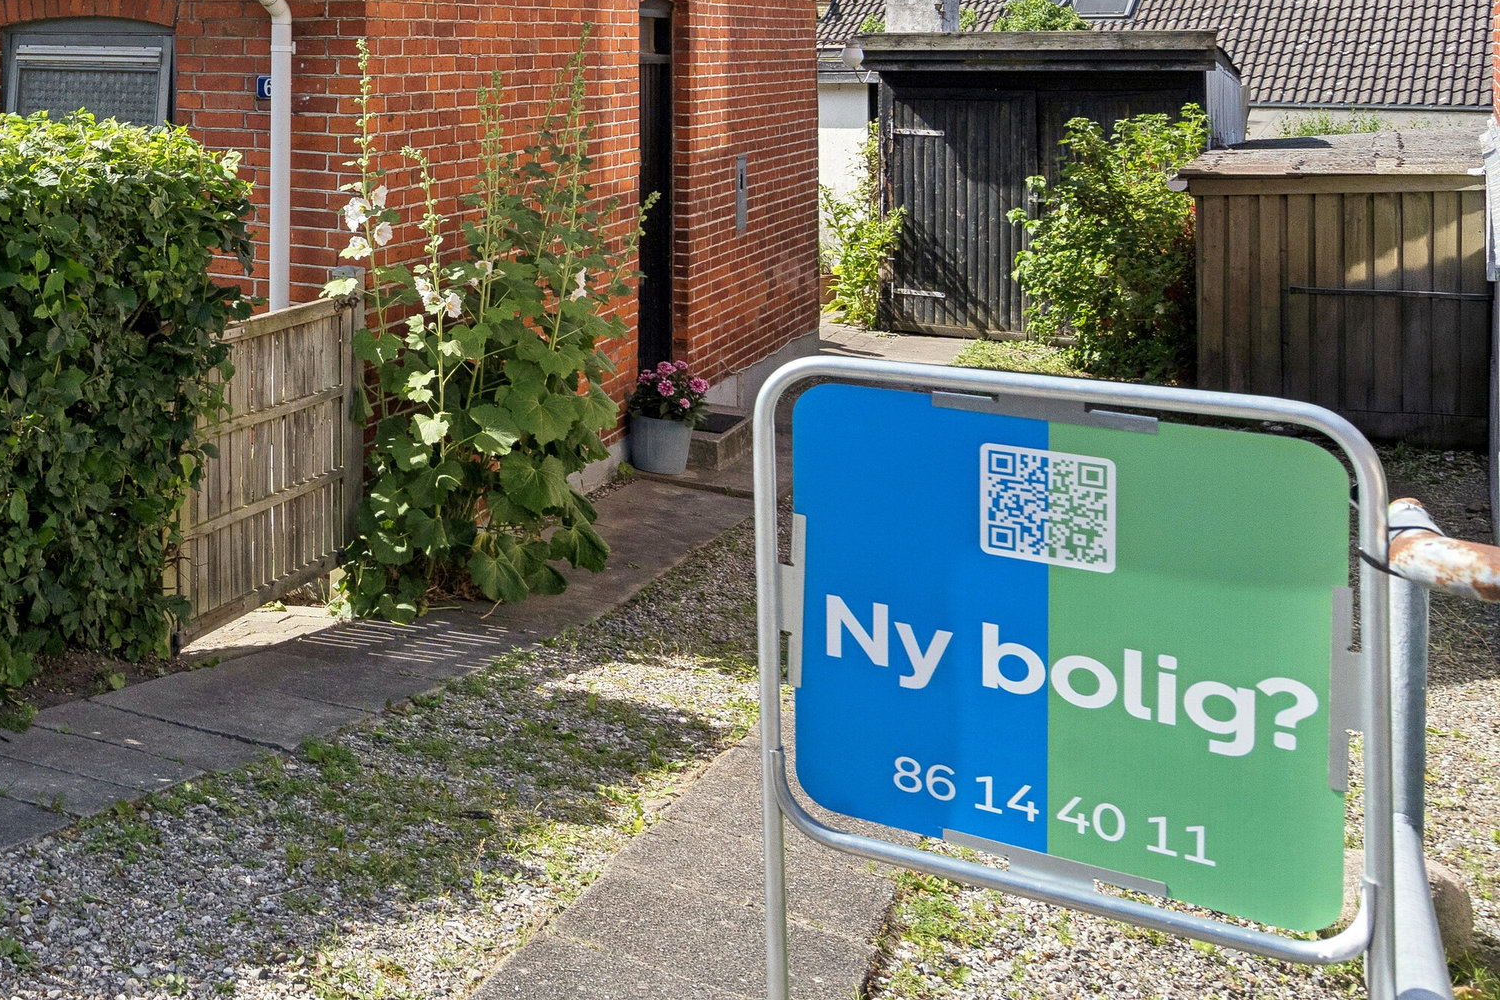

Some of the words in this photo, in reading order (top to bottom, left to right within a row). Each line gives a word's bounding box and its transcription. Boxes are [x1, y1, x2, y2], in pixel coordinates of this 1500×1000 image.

[825, 594, 954, 690] Ny
[981, 621, 1320, 758] bolig?
[892, 755, 957, 802] 86
[974, 775, 1040, 823] 14
[1055, 795, 1127, 843] 40
[1145, 815, 1217, 868] 11
